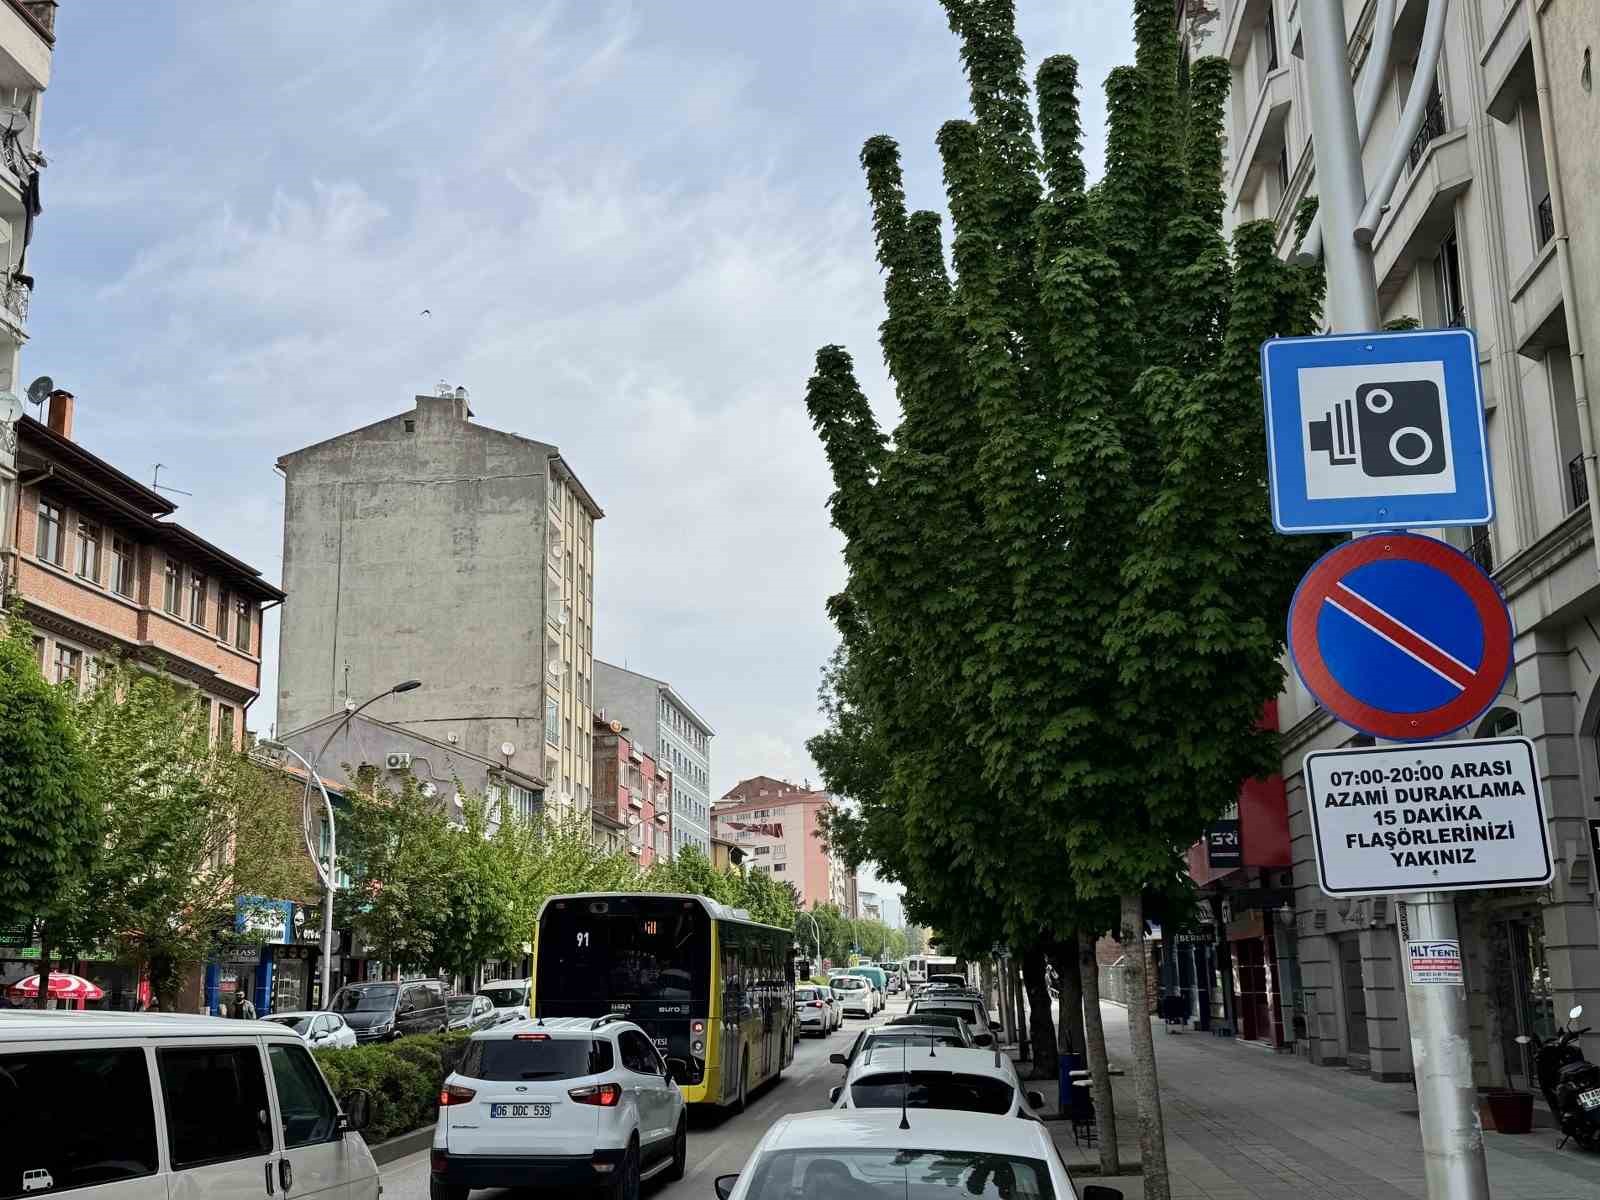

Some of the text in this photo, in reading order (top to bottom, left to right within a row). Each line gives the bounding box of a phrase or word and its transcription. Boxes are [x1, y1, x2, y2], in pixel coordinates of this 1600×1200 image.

[1330, 760, 1512, 786] 07:00-20:00 ARASI
[1325, 781, 1526, 808] AZAMİ DURAKLAMA
[1373, 803, 1482, 826] 15 DAKİKA
[1346, 820, 1515, 851] FLAŞÖRLERİNİZİ
[1390, 848, 1477, 868] YAKINIZ
[576, 931, 590, 947] 91
[1410, 945, 1429, 957] HLT
[496, 1105, 508, 1116] 06
[533, 1105, 550, 1116] 539
